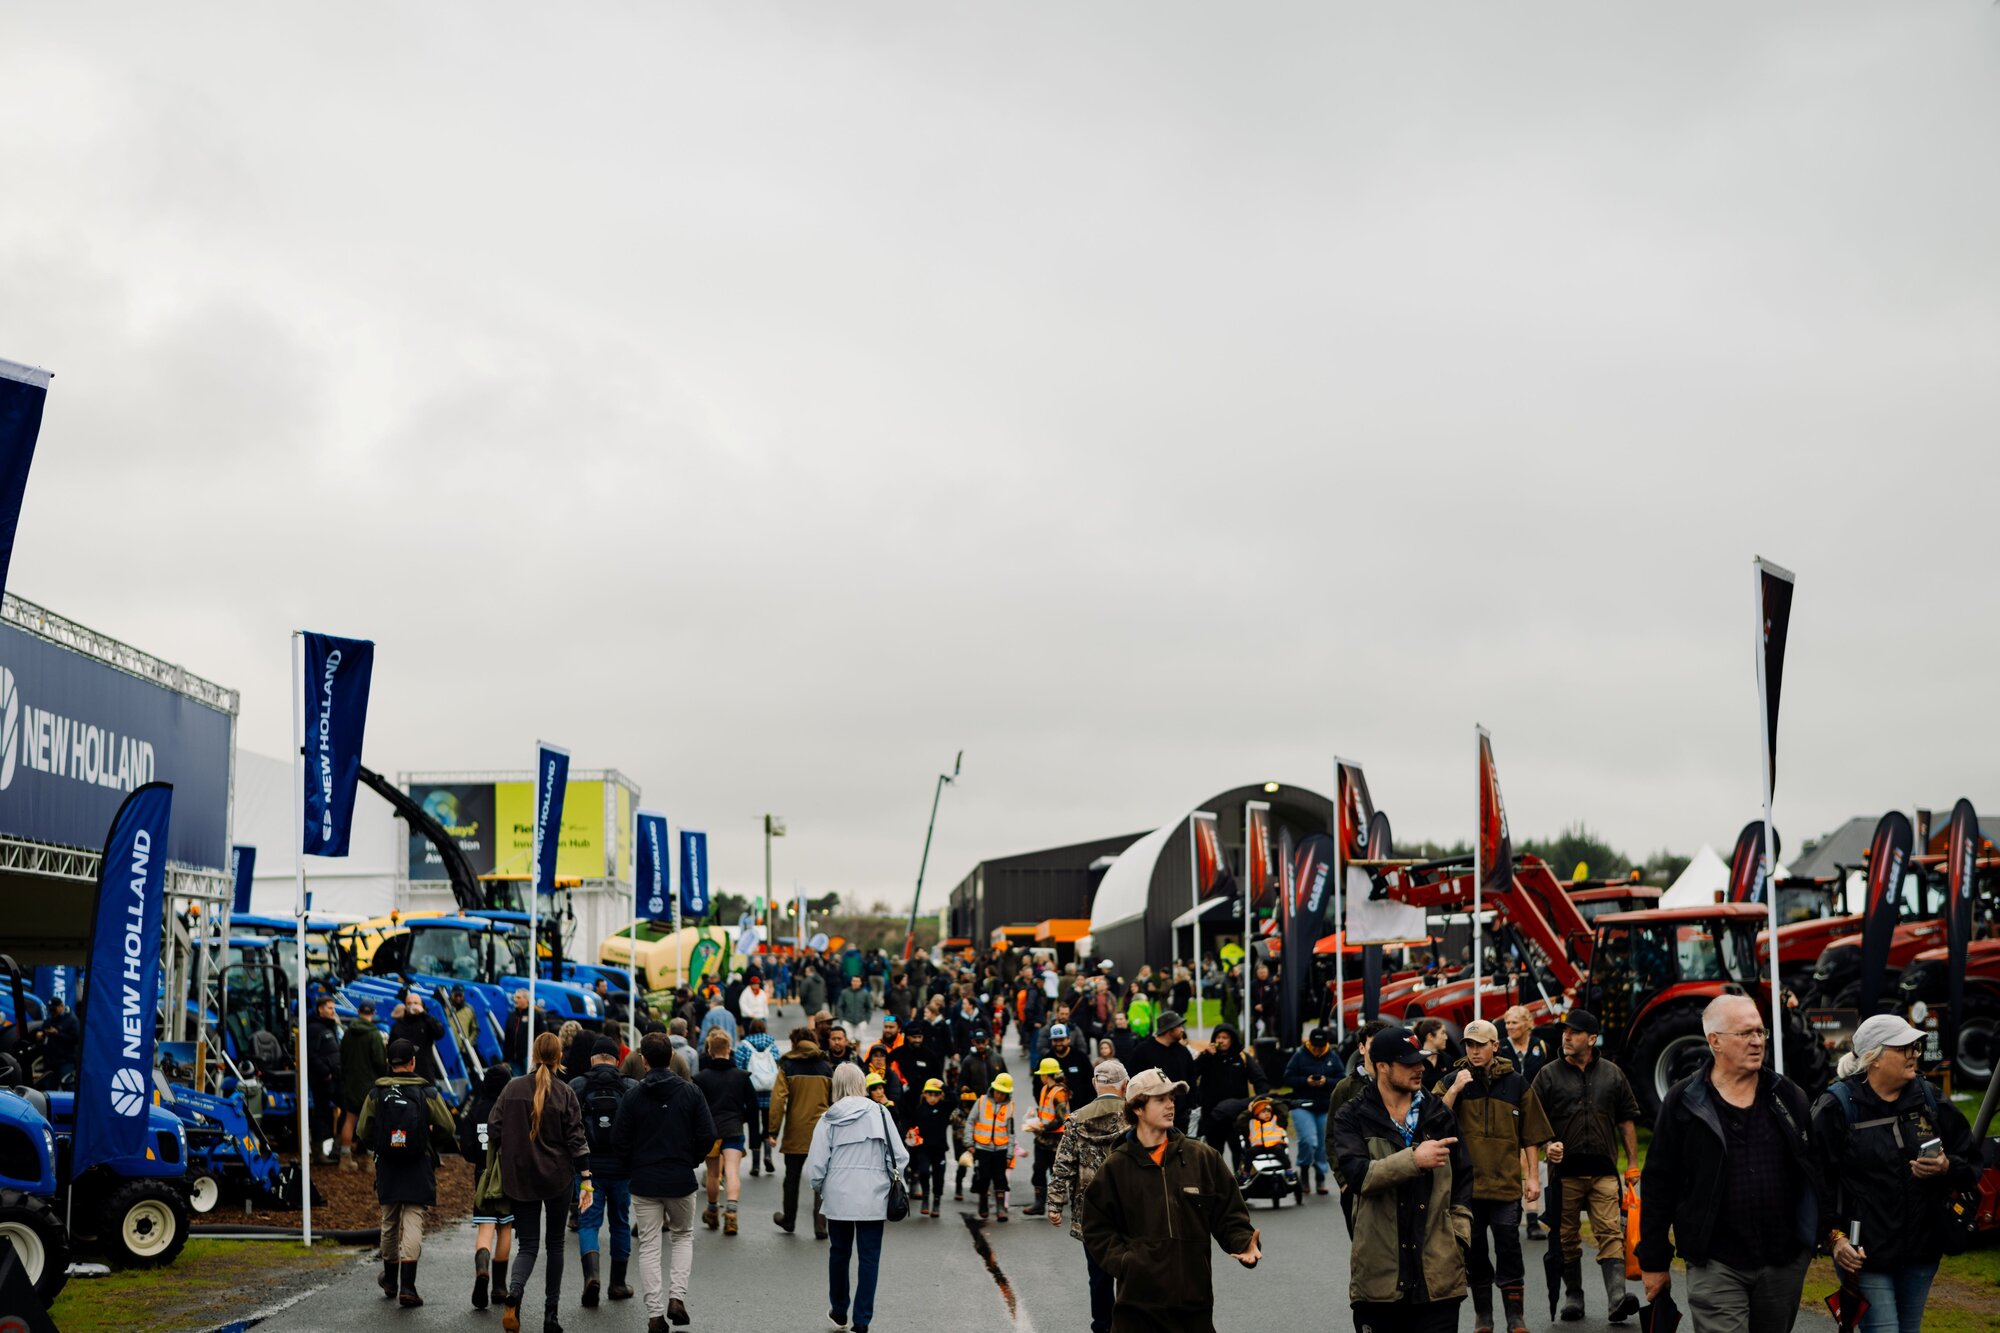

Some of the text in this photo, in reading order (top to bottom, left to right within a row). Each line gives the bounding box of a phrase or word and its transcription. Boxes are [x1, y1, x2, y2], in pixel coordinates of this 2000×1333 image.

[24, 705, 155, 792] NEW HOLLAND
[319, 649, 342, 803] NEW HOLLAND
[540, 759, 556, 826] HOLLAND
[570, 838, 590, 848] Hub
[650, 821, 661, 870] HOLLAND
[1307, 874, 1326, 912] CASE
[122, 829, 151, 1059] NEW HOLLAND
